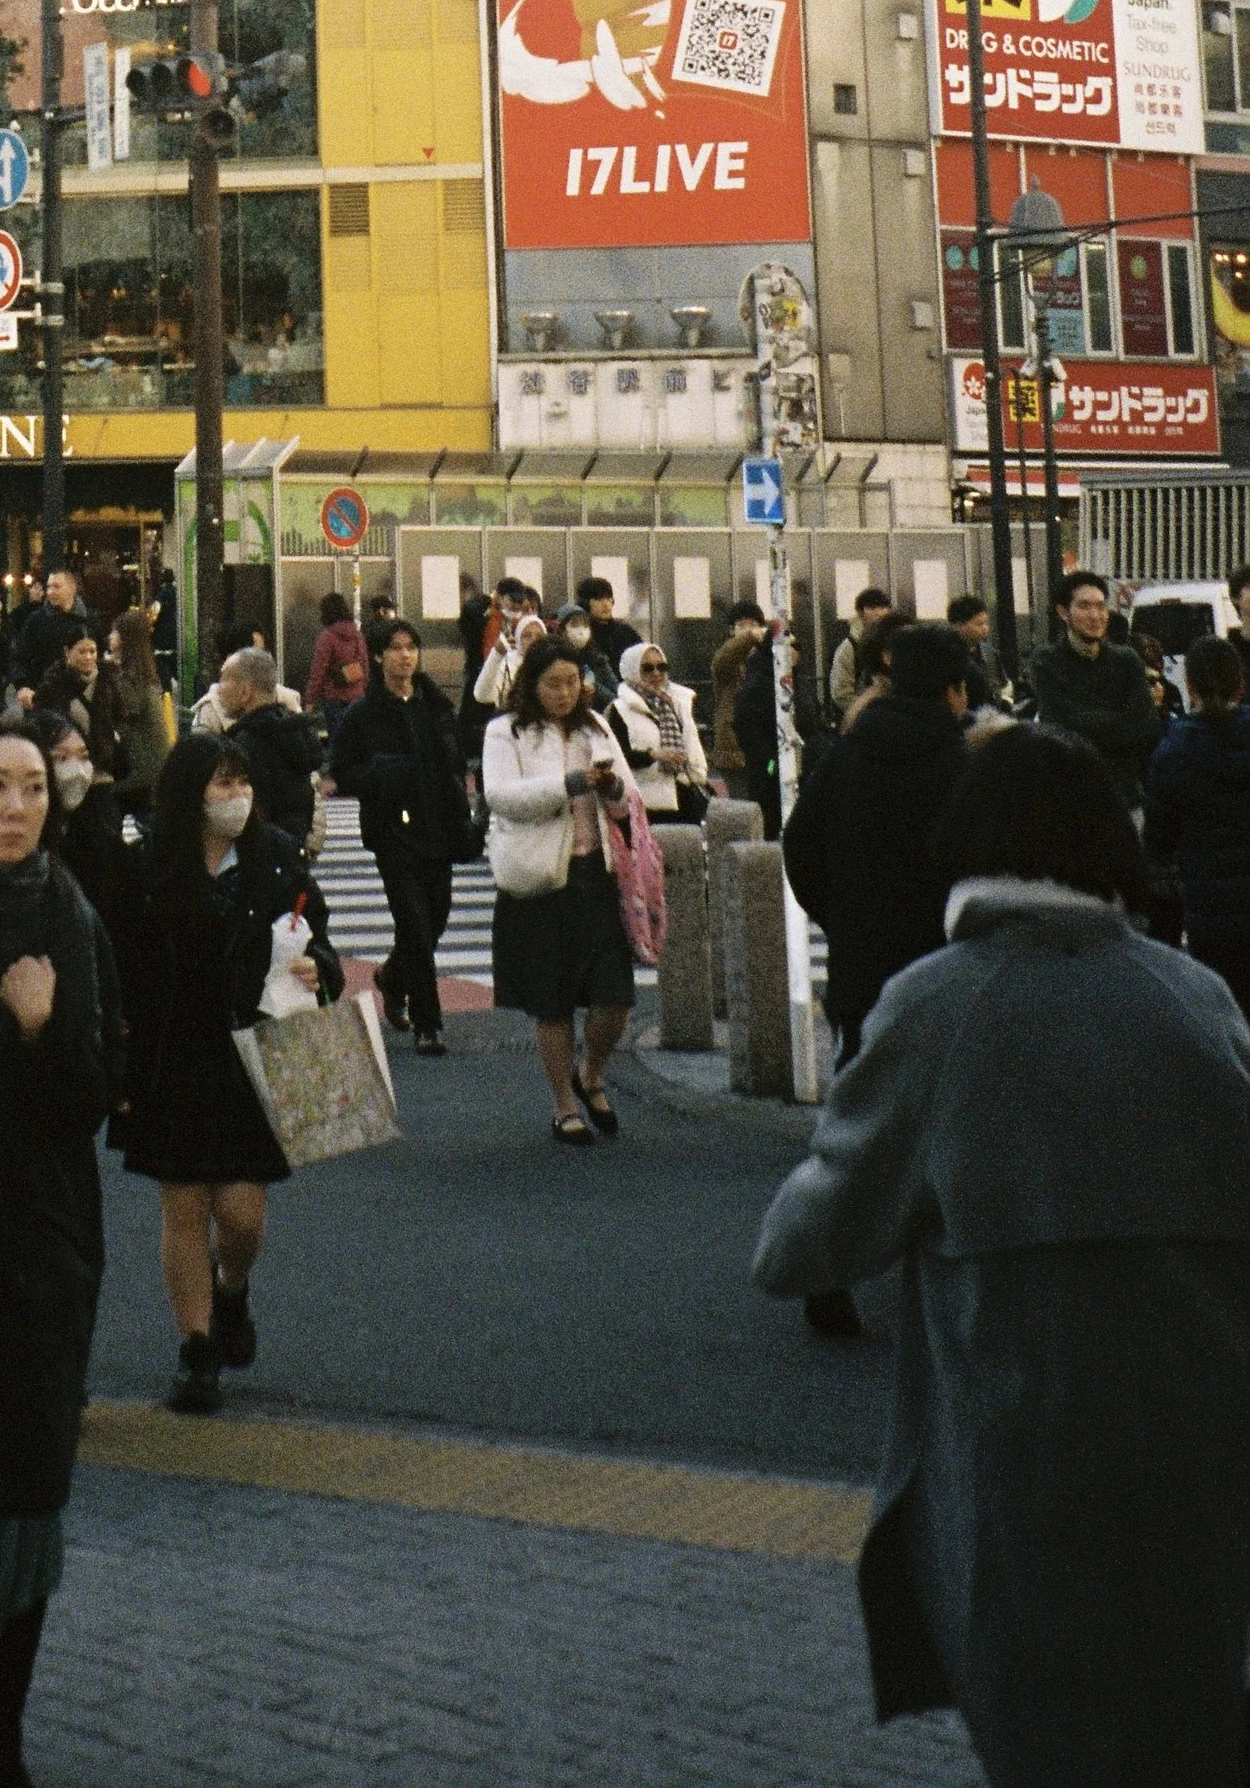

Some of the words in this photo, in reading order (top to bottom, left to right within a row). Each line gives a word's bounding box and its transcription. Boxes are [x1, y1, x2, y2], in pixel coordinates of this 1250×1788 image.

[1126, 13, 1178, 35] Tax-free
[945, 30, 997, 54] DRG
[1002, 34, 1016, 55] &
[1018, 35, 1110, 64] COSMETIC
[1136, 36, 1168, 56] Shop
[1123, 61, 1191, 82] SUNDRUG
[944, 62, 1113, 117] サンドラッグ
[565, 141, 749, 197] 17LIVE
[519, 366, 754, 396] 渋谷駅前ビ
[1069, 385, 1209, 424] サンドラッグ
